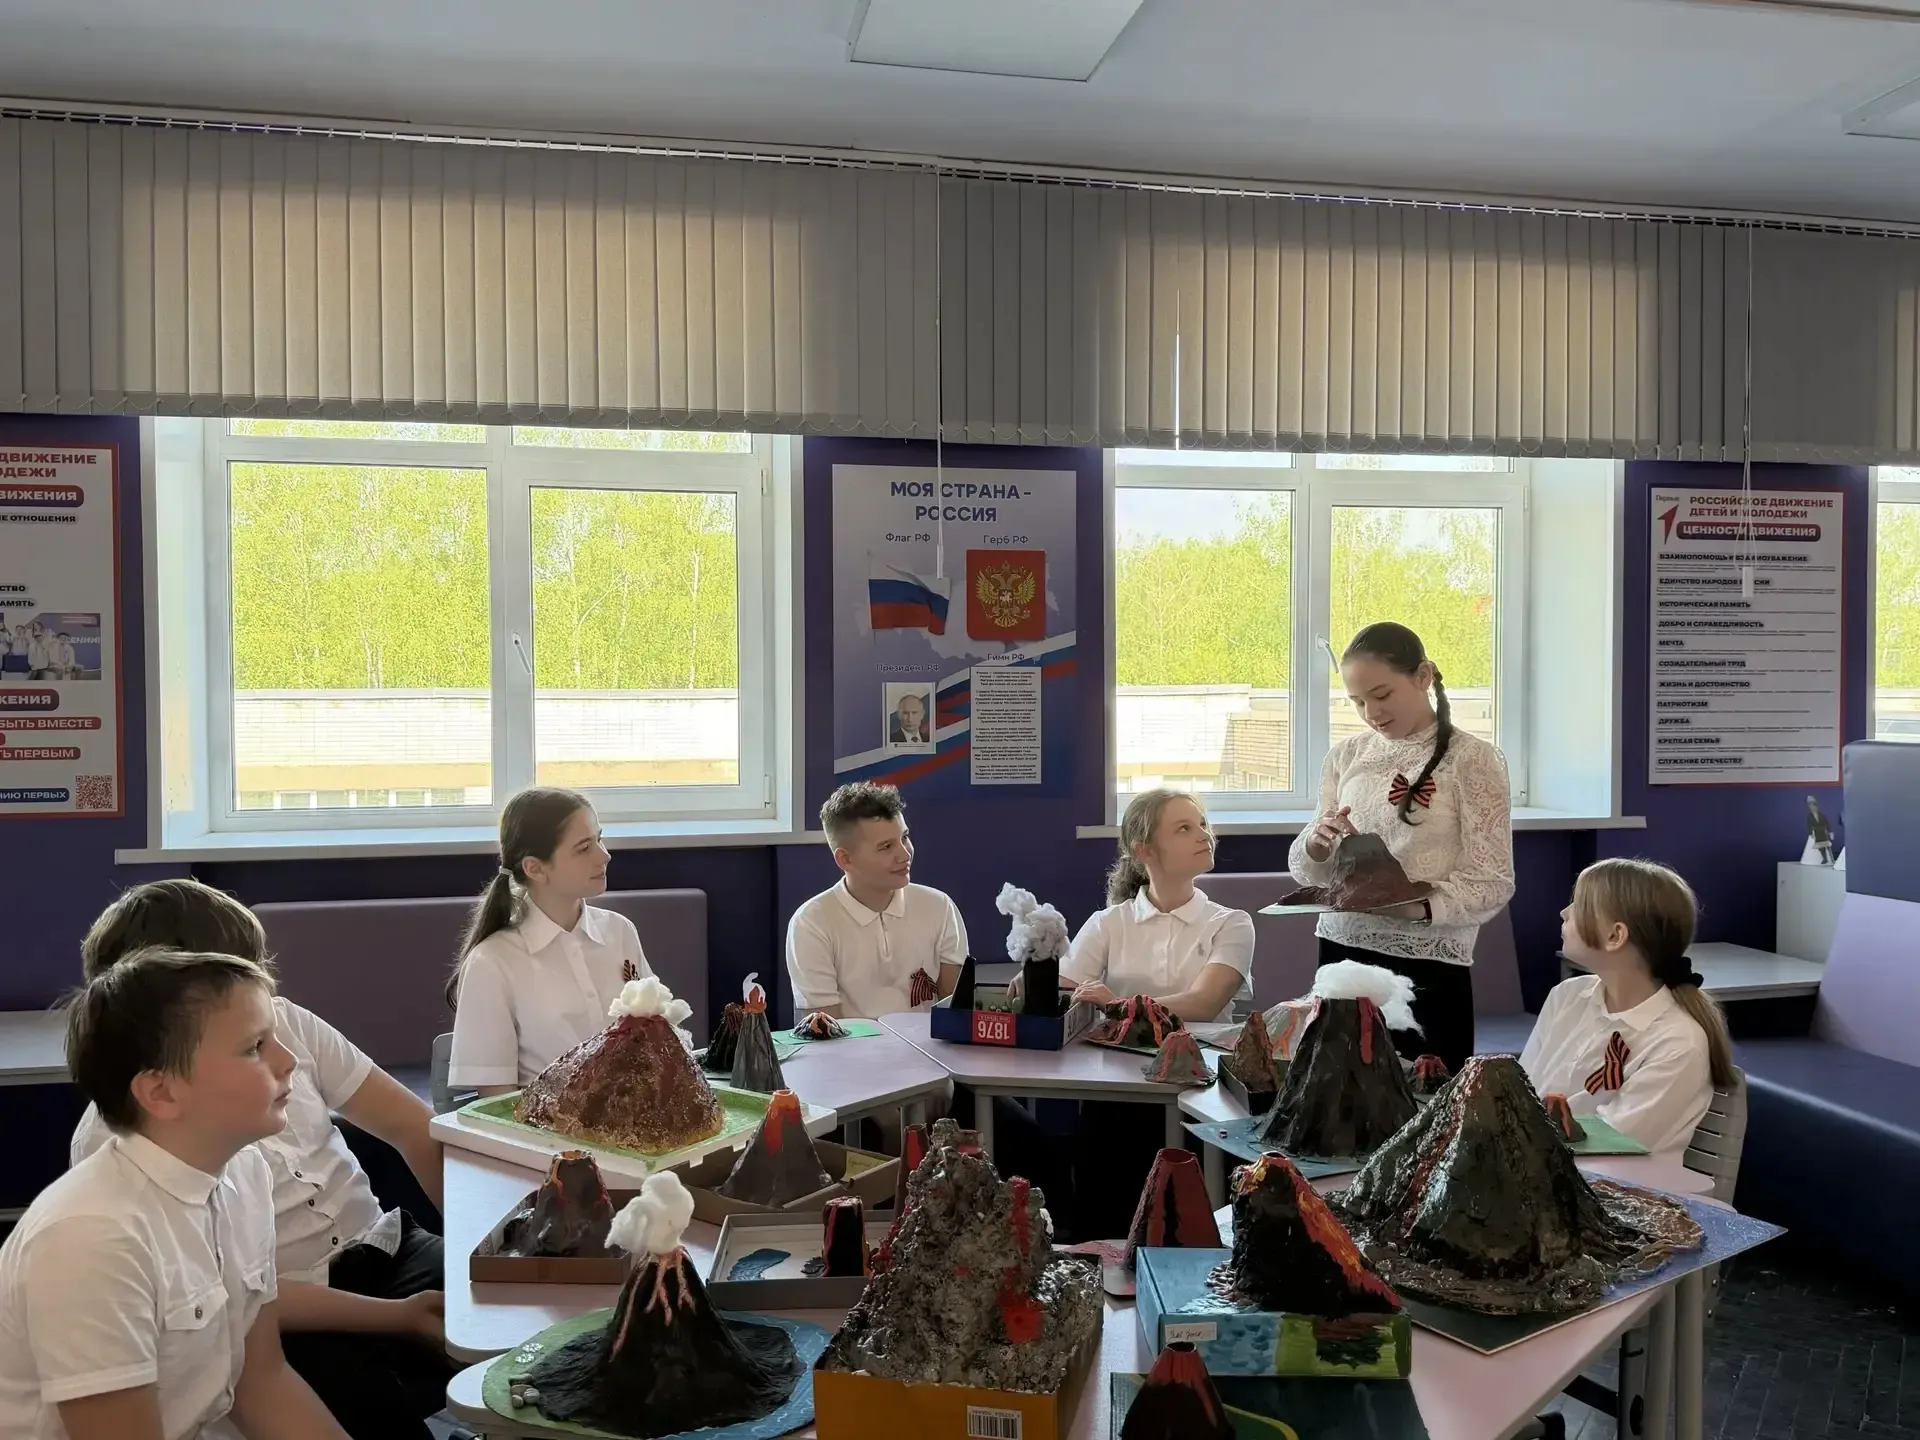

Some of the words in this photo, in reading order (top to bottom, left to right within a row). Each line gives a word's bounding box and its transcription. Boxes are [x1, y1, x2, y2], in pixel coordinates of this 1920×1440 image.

[0, 452, 97, 465] ДВИЖЕНИЕ
[890, 481, 934, 498] МОЯ
[941, 482, 1020, 500] СТРАНА
[1769, 498, 1834, 508] ДВИЖЕНИЕ
[915, 505, 998, 522] РОССИЯ
[1689, 506, 1728, 517] ДЕТЕЙ
[1730, 508, 1738, 517] И
[10, 514, 76, 523] ОТНОШЕНИЯ
[885, 532, 912, 543] Флаг
[914, 533, 932, 543] РФ
[983, 535, 1010, 546] Герб
[1012, 535, 1029, 545] РФ
[987, 653, 1010, 662] Гимн
[1011, 653, 1025, 662] РФ
[876, 663, 924, 673] Президент
[927, 663, 940, 672] РФ
[0, 719, 35, 728] БЫТЬ
[38, 719, 93, 728] ВМЕСТЕ
[14, 749, 74, 758] ПЕРВЫМ
[23, 791, 67, 799] ПЕРВЫХ
[977, 1021, 1010, 1040] 1876
